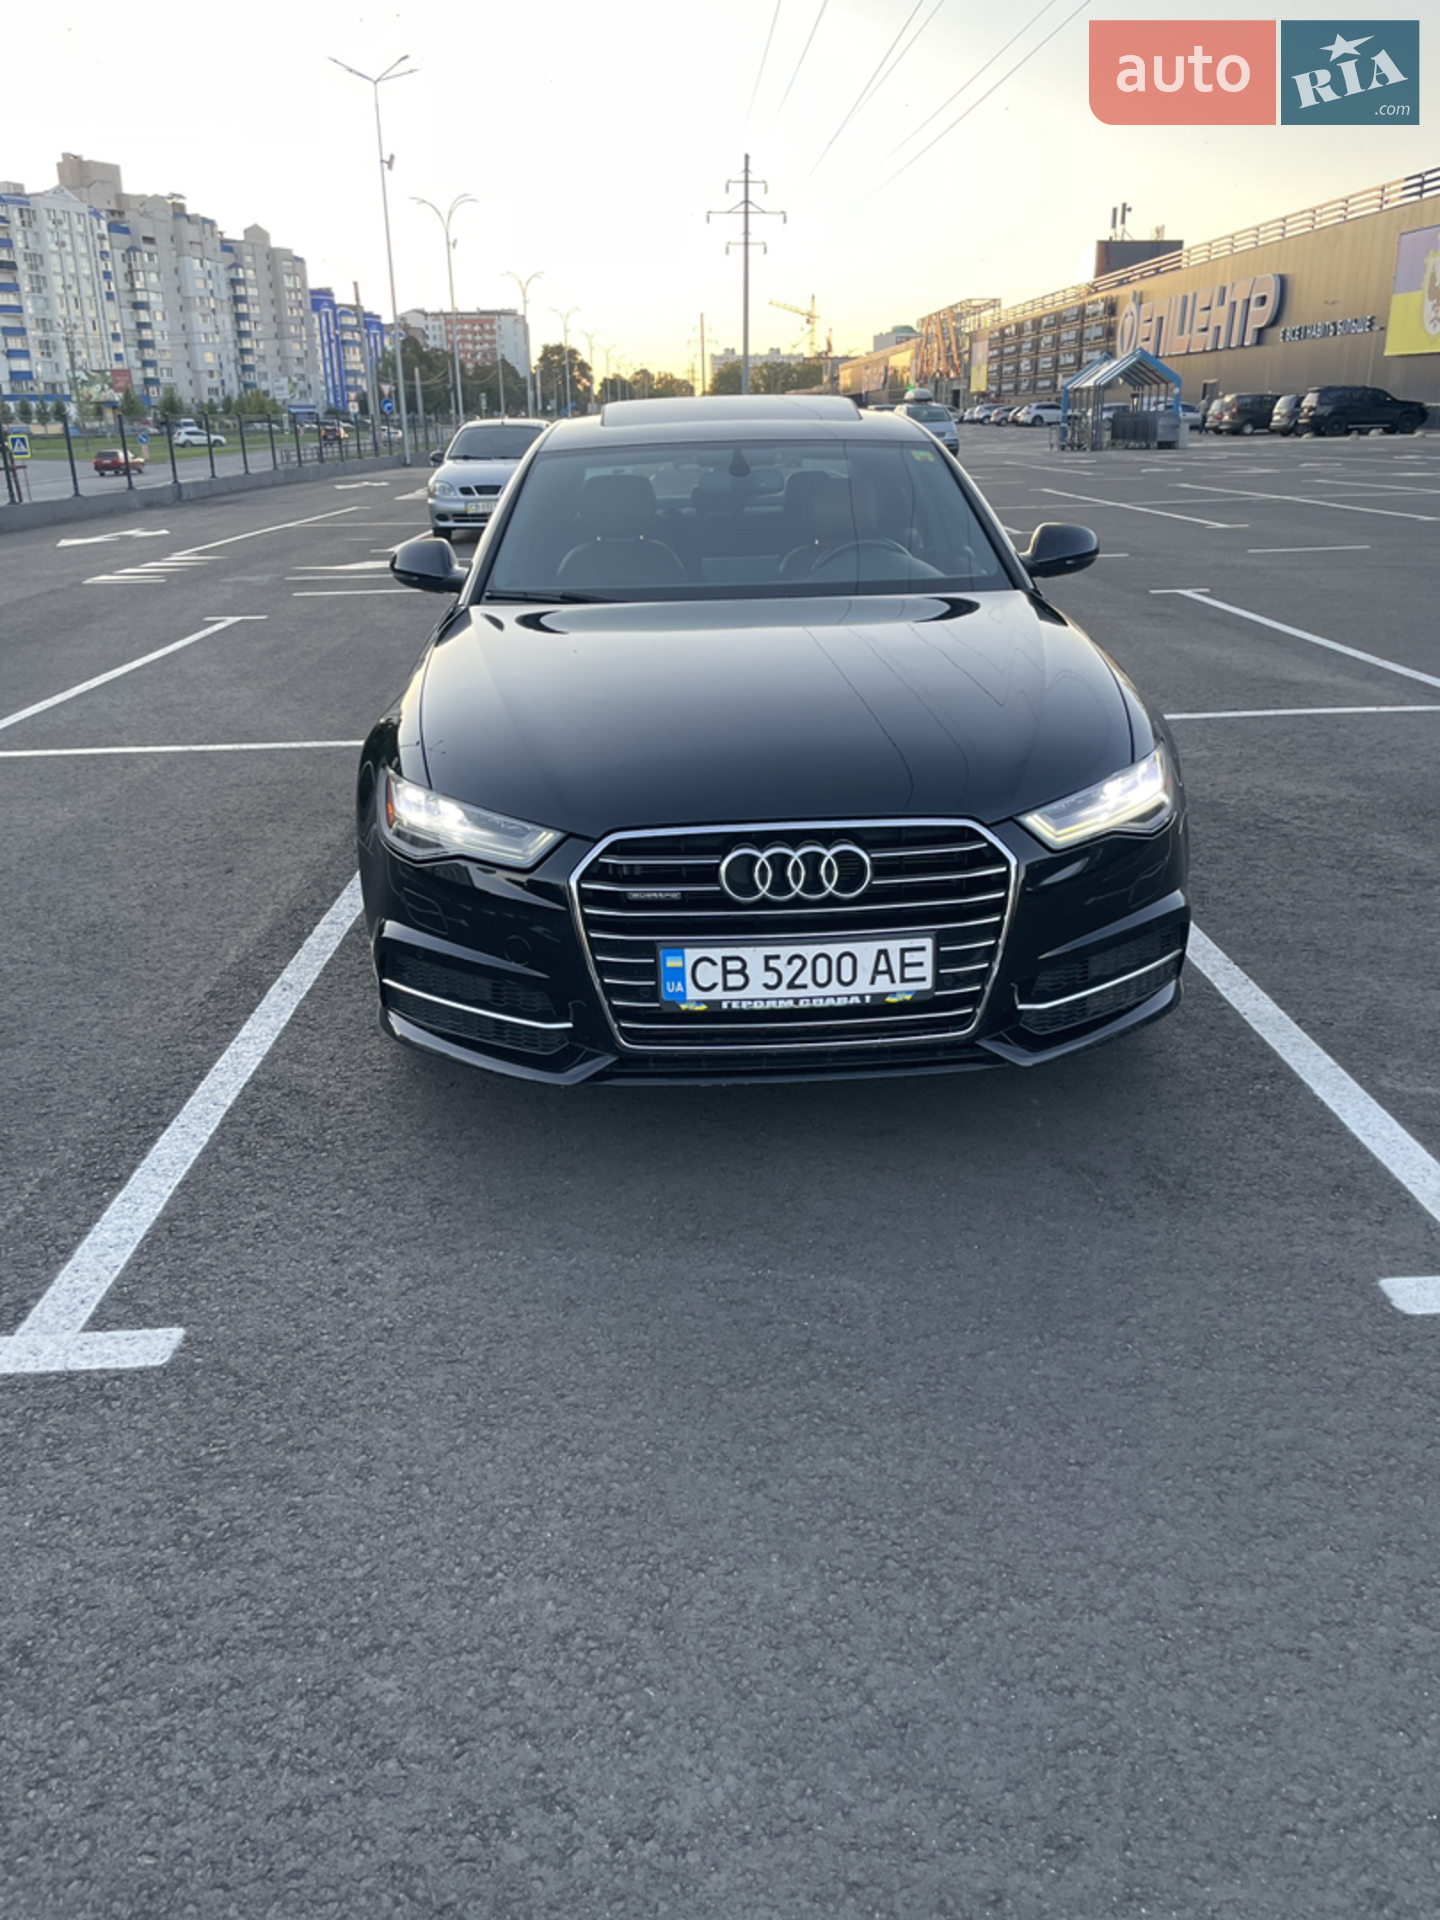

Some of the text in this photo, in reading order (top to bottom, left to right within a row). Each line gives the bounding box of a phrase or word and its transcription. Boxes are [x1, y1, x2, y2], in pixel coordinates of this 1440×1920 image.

[690, 945, 927, 993] CB 5200 AE
[666, 981, 684, 993] UA
[721, 999, 795, 1011] ГЕРОЯМ
